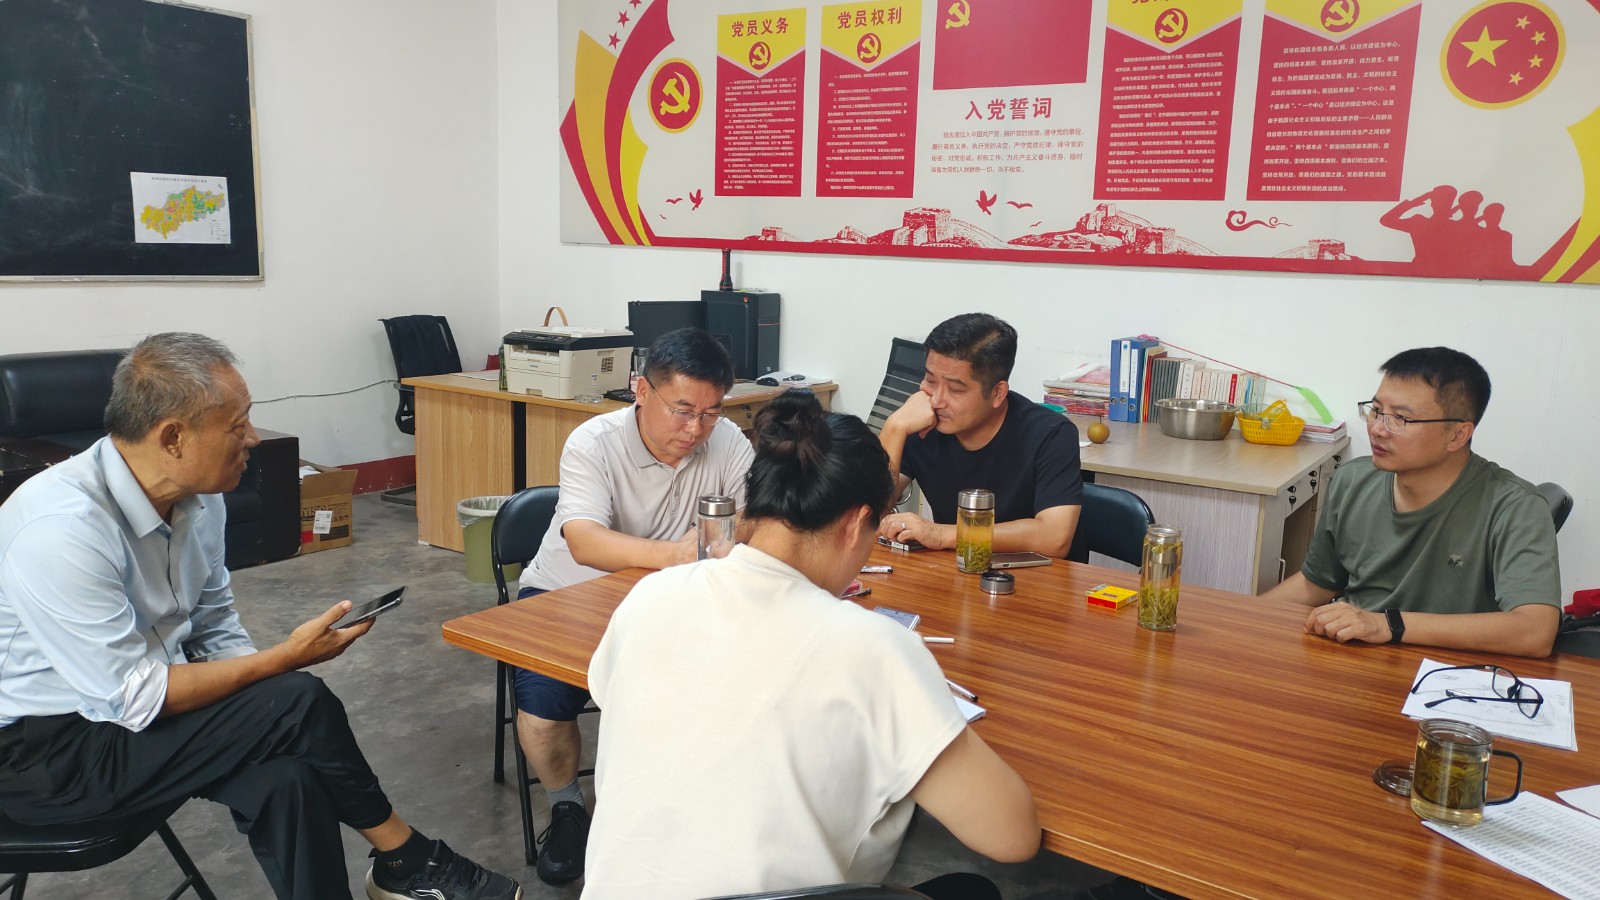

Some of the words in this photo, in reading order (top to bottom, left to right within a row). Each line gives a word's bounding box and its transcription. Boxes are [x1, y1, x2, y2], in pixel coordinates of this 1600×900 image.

[731, 16, 789, 38] 党员义务
[837, 6, 902, 30] 党员权利
[964, 97, 1053, 121] 入党誓词
